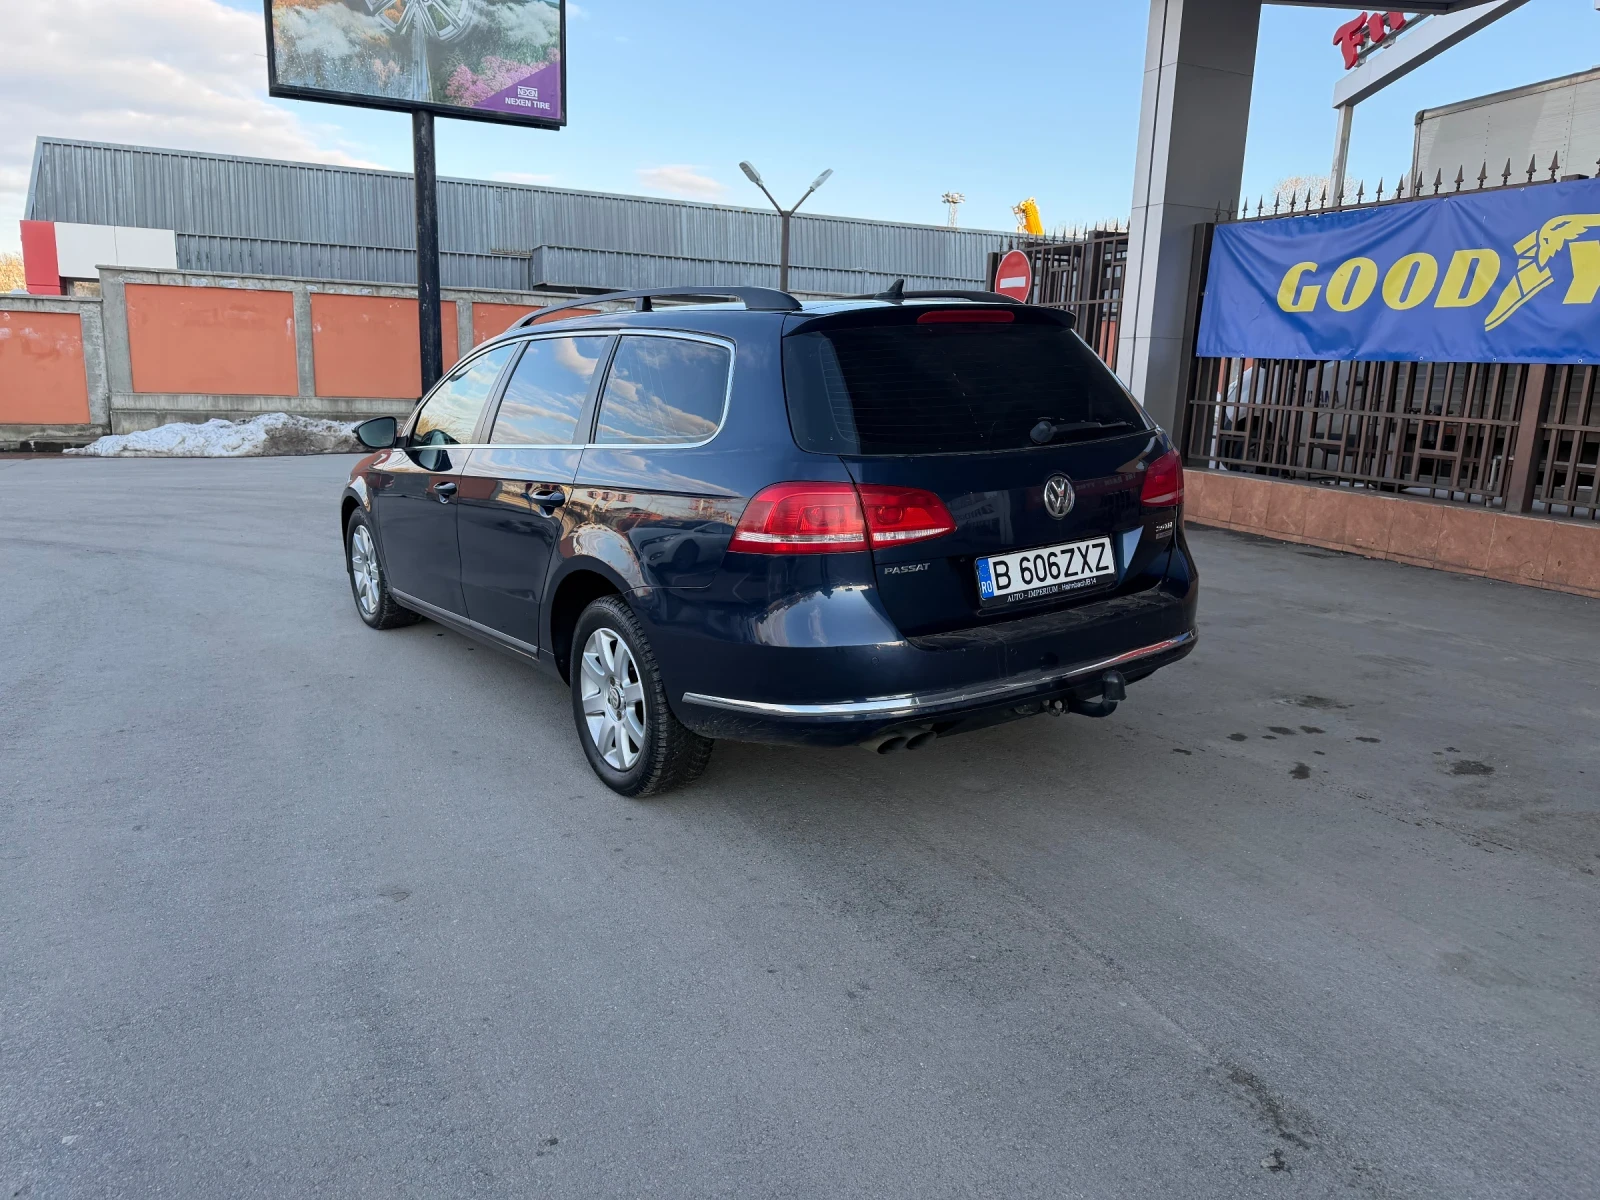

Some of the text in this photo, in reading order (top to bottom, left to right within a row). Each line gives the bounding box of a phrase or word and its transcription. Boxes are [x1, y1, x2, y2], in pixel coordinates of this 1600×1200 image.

[505, 97, 550, 110] NEXEN TIRE
[884, 562, 930, 575] PASSAT
[993, 542, 1109, 590] B 606ZXZ
[981, 581, 993, 593] RO
[1007, 592, 1024, 602] AUTO
[1028, 586, 1059, 598] IMPERIUM
